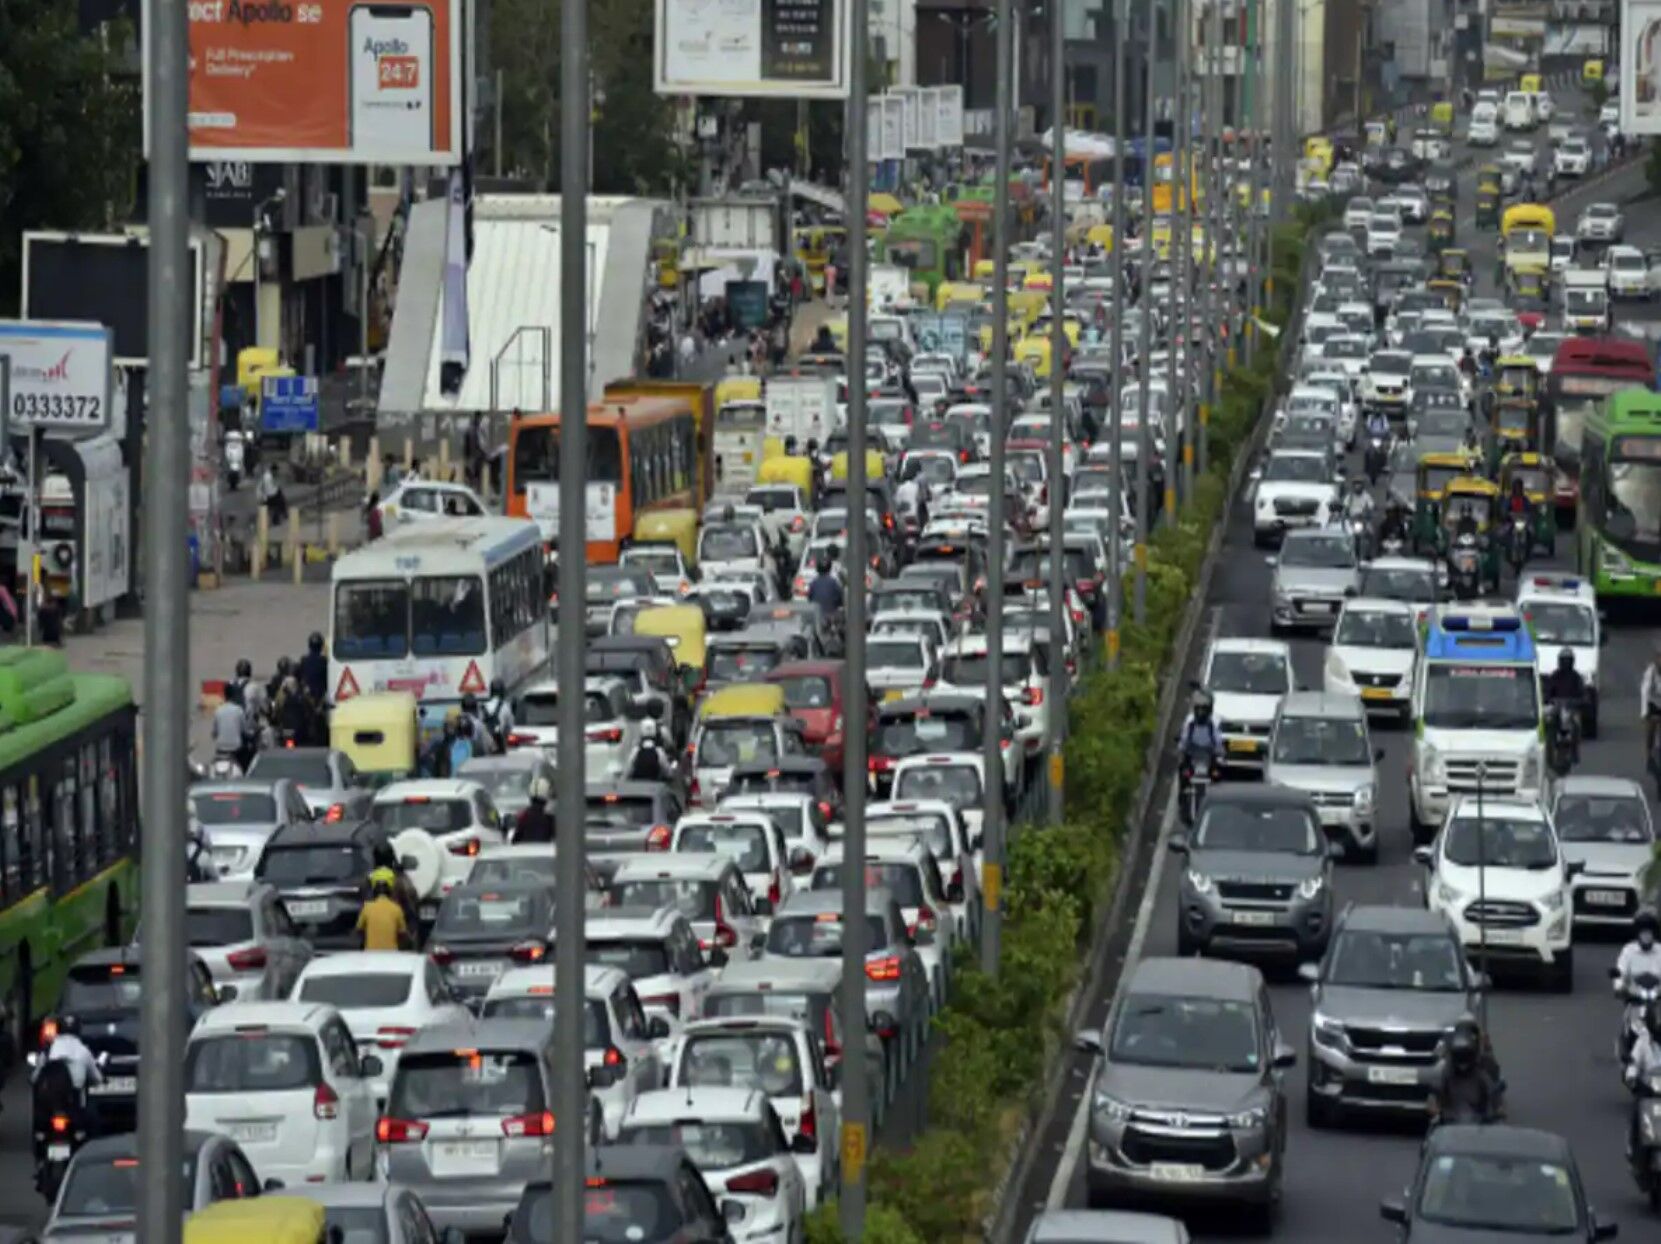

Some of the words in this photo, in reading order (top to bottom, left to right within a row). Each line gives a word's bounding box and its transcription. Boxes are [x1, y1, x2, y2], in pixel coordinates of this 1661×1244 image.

[298, 4, 322, 23] se
[363, 36, 408, 61] Apollo
[14, 393, 100, 418] 0333372
